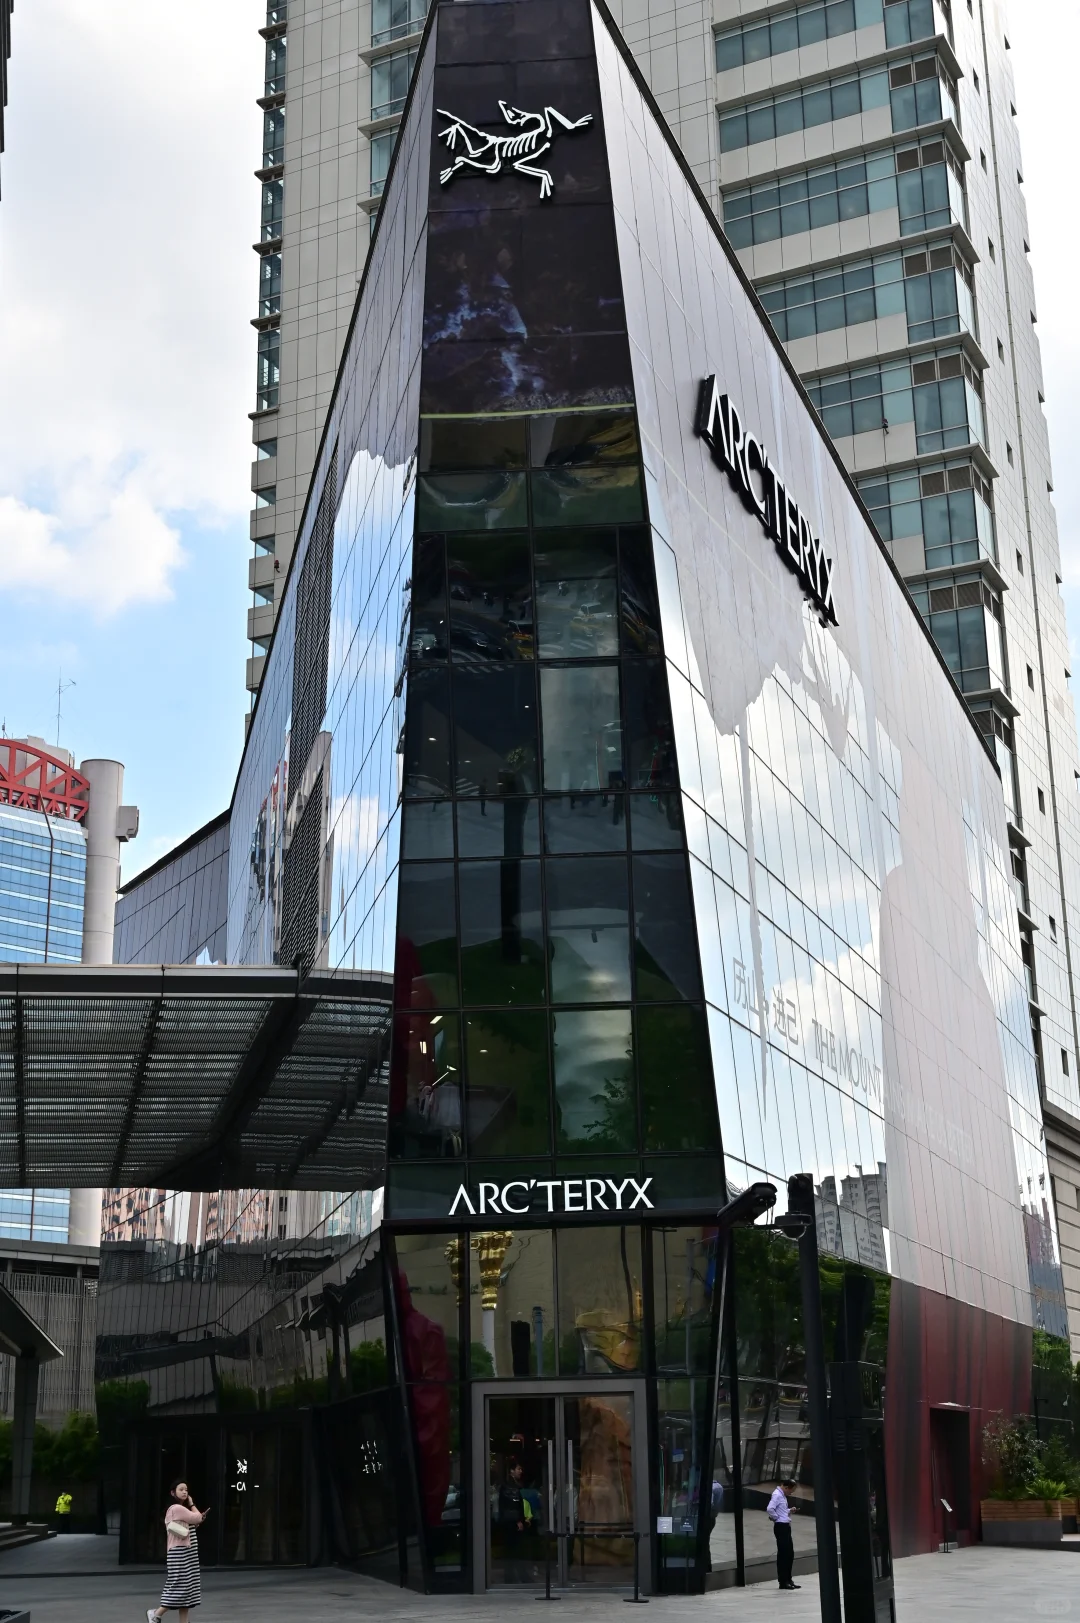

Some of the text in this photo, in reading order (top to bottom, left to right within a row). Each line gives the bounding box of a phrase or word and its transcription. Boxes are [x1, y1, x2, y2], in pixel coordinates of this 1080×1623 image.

[701, 374, 839, 626] ARC'TERYX
[812, 1018, 837, 1073] THE
[448, 1177, 655, 1216] ARC'TERYX
